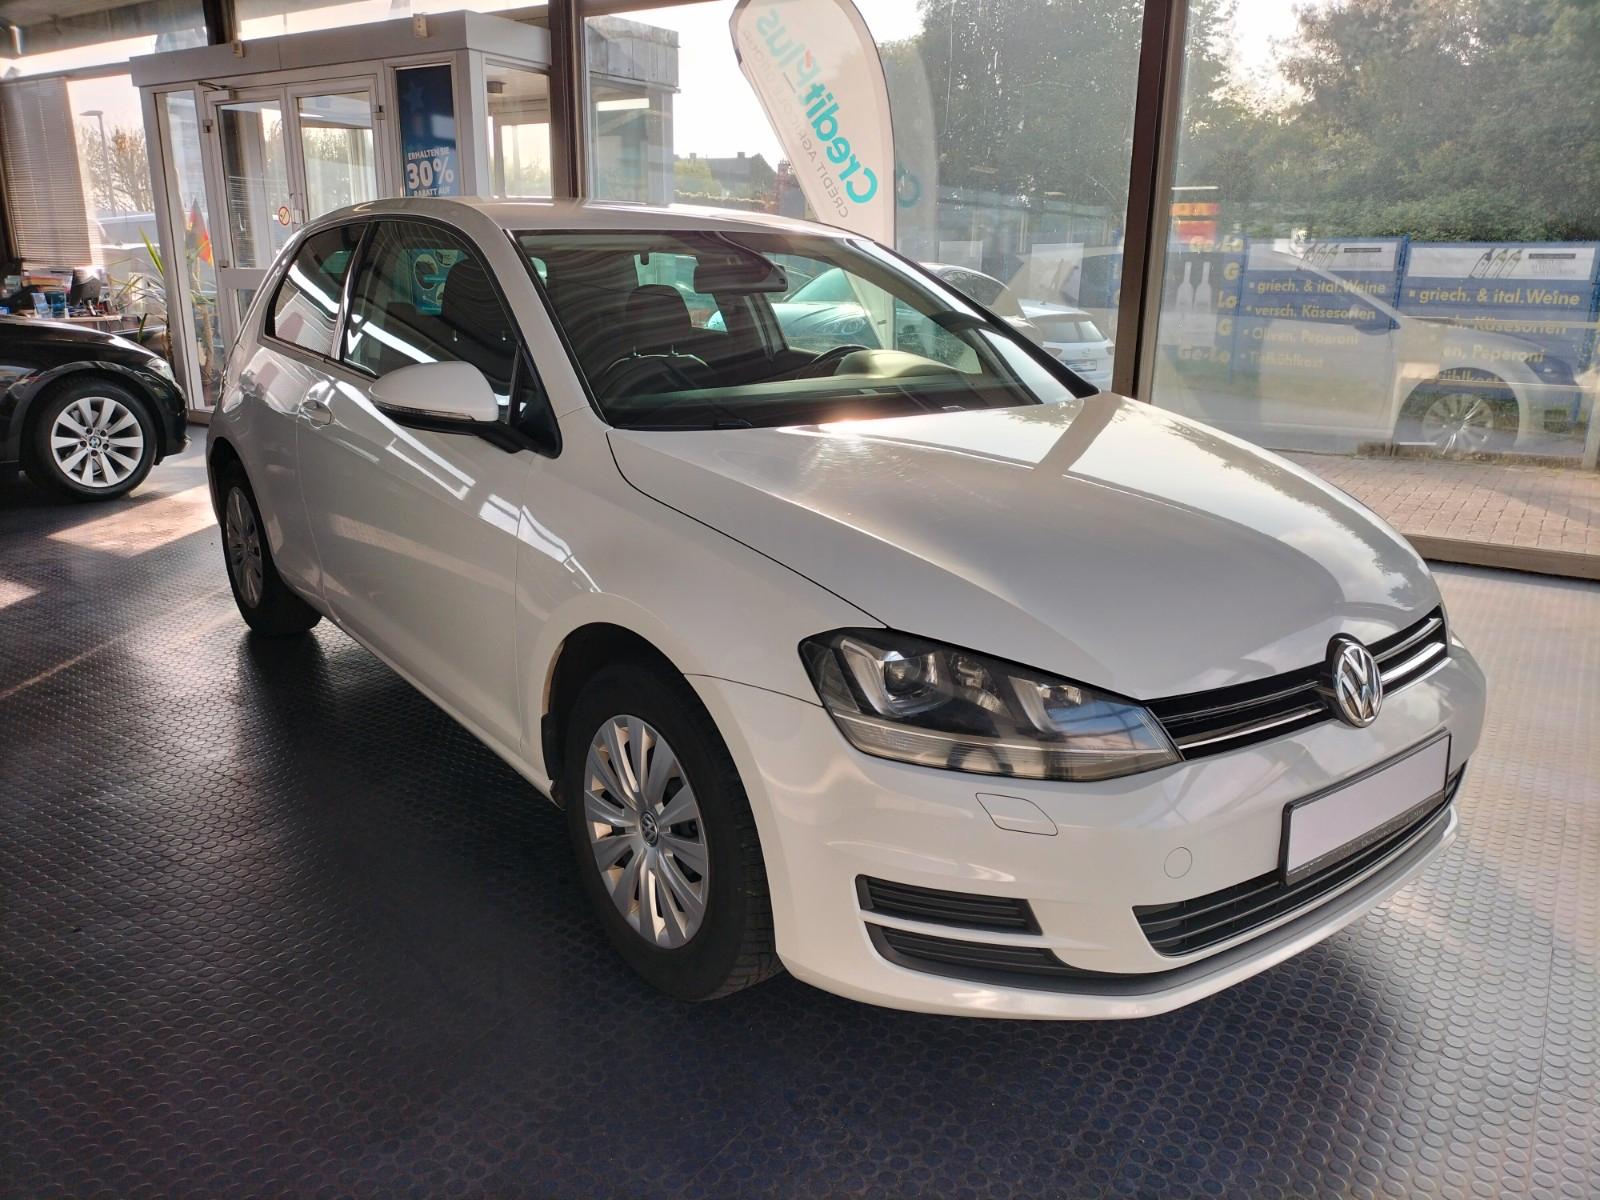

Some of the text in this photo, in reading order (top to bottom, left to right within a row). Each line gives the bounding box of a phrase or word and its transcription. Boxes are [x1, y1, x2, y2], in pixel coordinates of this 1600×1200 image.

[407, 157, 454, 189] 30%
[1257, 281, 1299, 294] griech.
[1304, 281, 1313, 293] &
[1419, 287, 1471, 304] griech.
[1476, 288, 1488, 303] &
[1255, 305, 1297, 318] versch.
